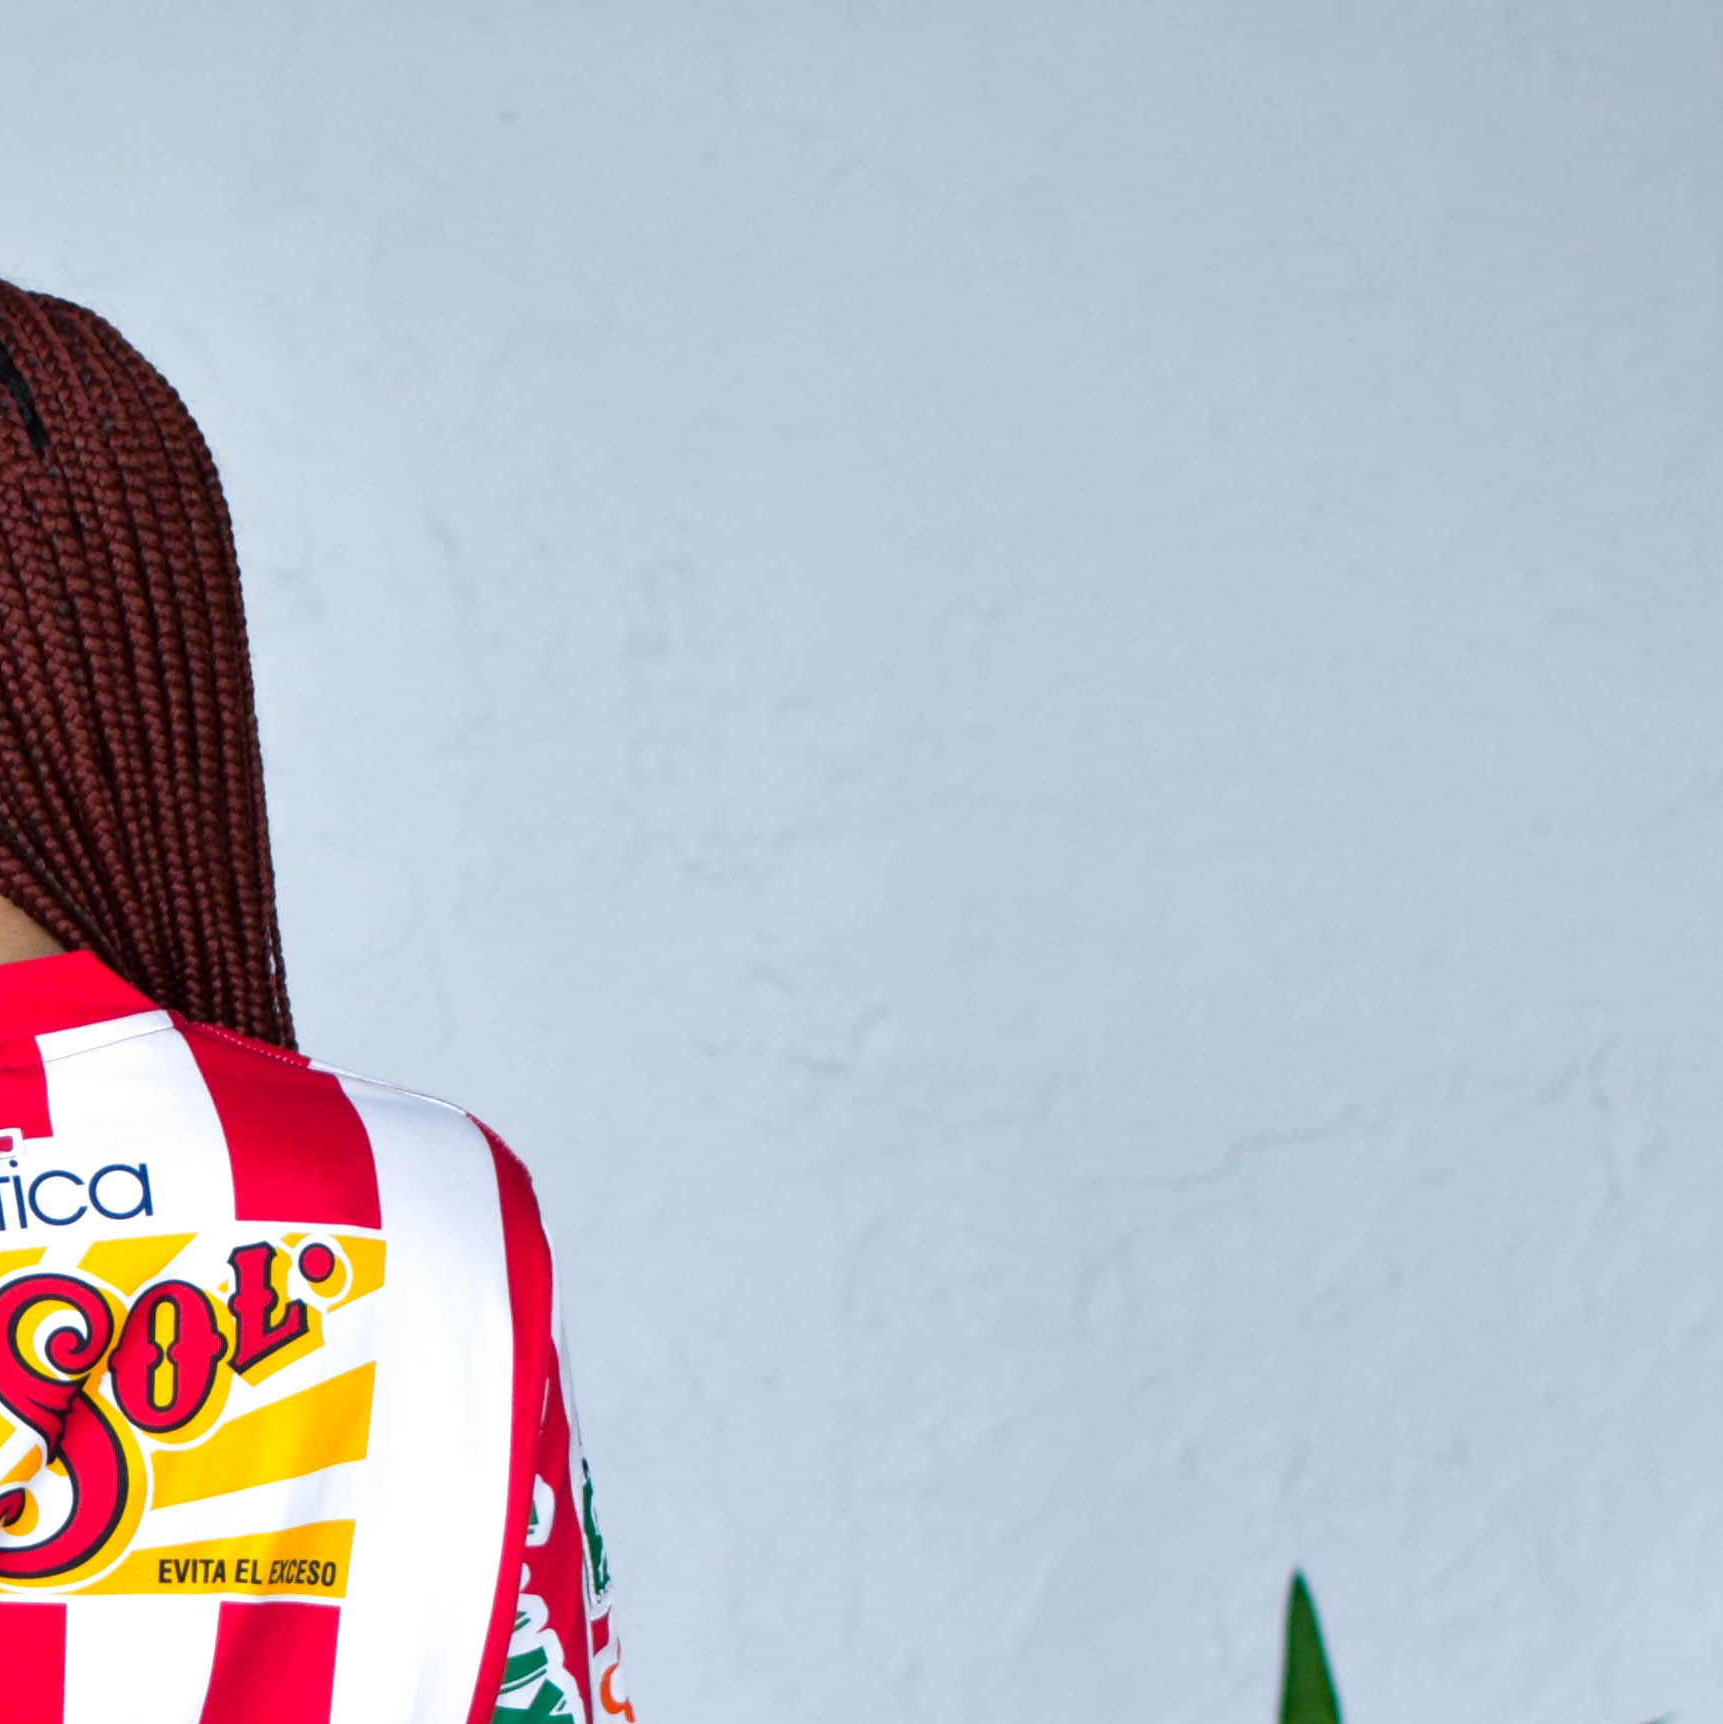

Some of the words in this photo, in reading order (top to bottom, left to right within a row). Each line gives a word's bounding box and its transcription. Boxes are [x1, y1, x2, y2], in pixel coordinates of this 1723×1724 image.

[158, 1558, 226, 1584] EVITA
[234, 1558, 263, 1585] EL
[268, 1559, 337, 1587] EXCESO
